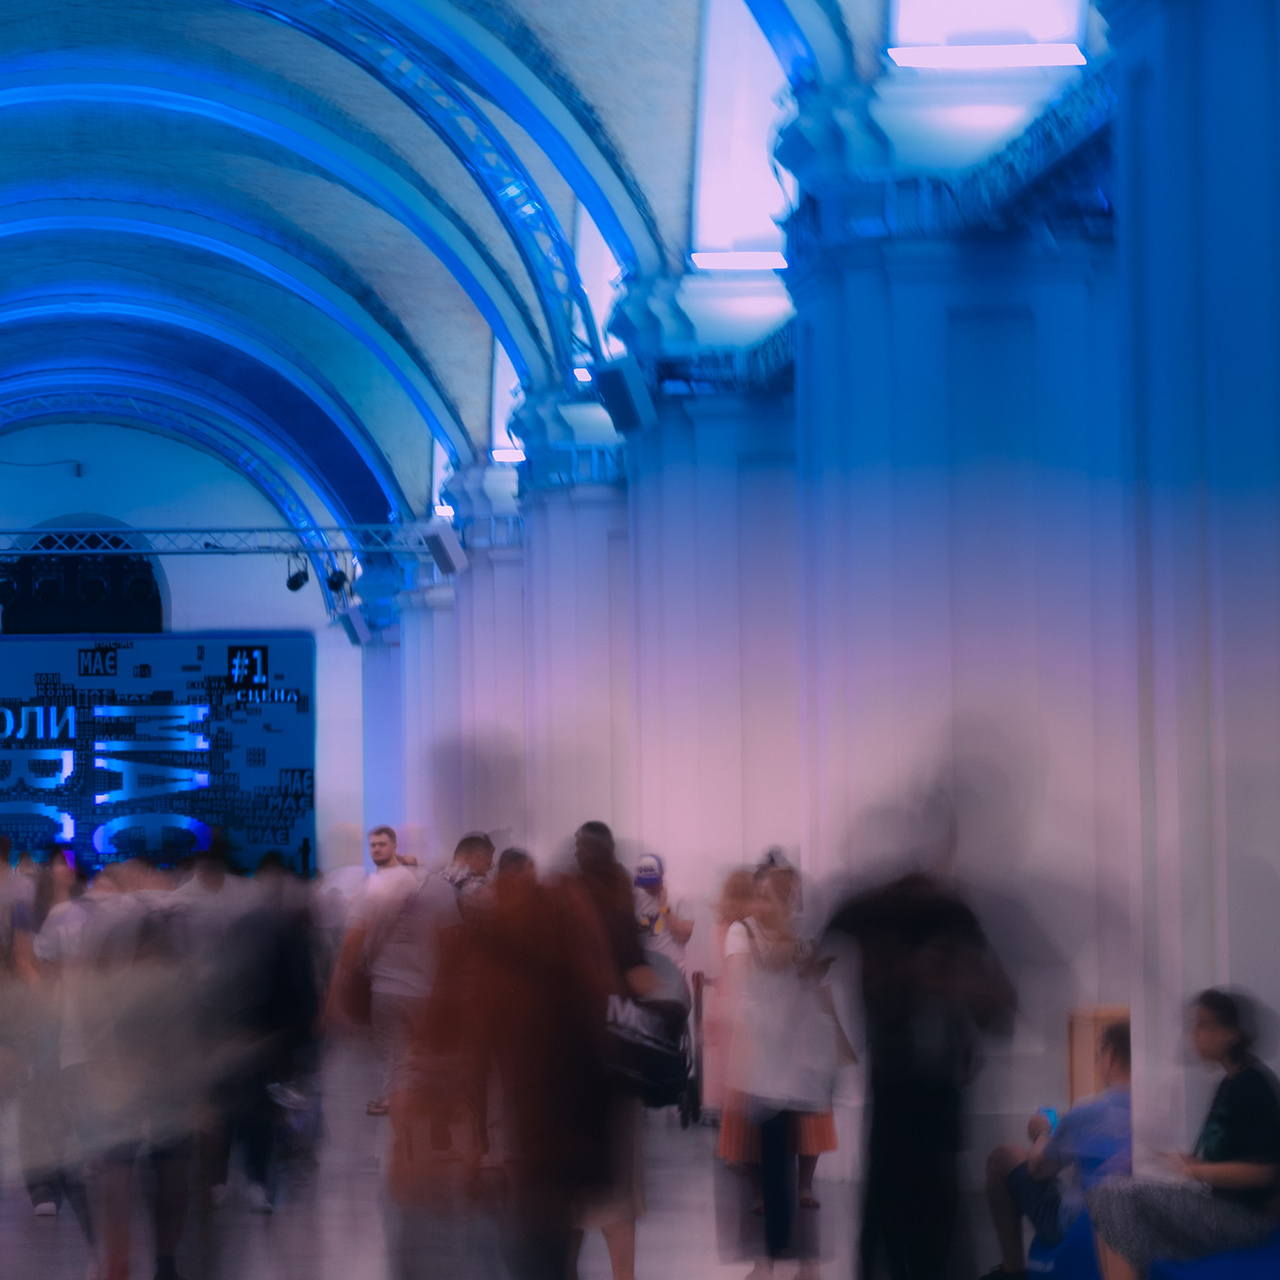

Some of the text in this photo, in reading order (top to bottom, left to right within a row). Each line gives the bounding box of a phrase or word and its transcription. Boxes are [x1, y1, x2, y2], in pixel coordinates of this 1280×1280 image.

[79, 651, 116, 675] МАЄ
[231, 649, 267, 684] #1
[237, 688, 298, 703] СЦЕНА
[280, 771, 312, 794] МАЄ
[269, 796, 311, 810] МАЄ
